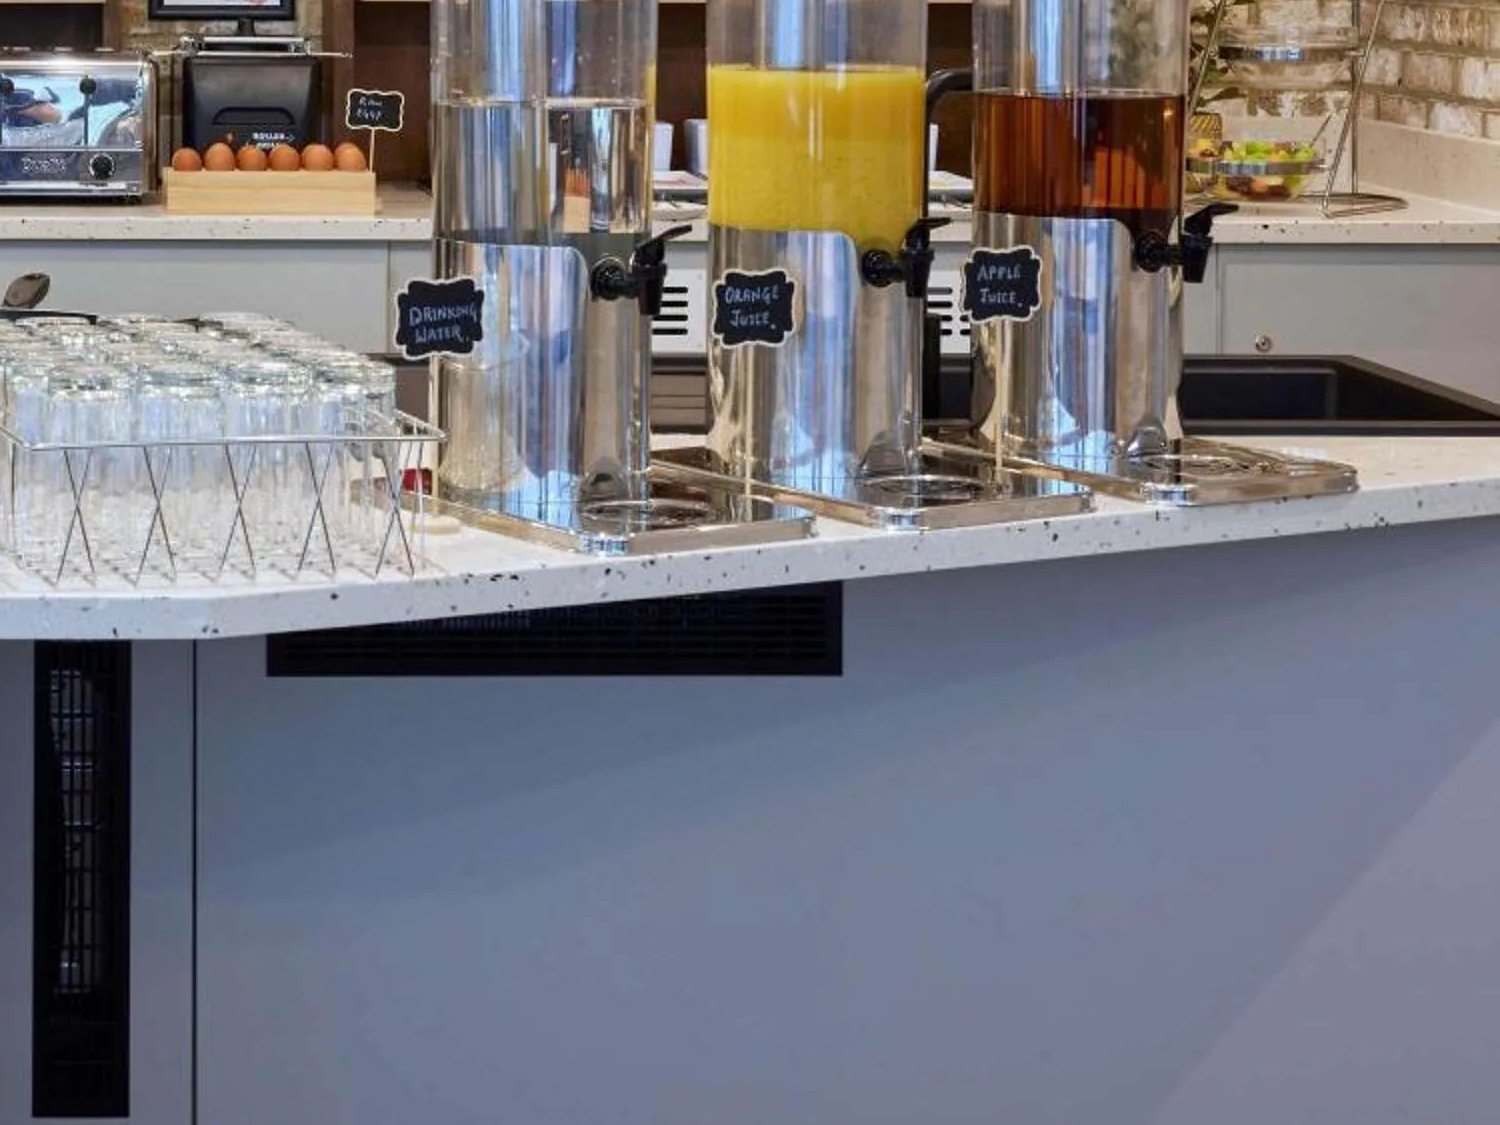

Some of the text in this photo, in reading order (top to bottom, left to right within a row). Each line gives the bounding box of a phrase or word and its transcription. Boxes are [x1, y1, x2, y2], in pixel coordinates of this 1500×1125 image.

[976, 263, 1022, 282] APPLE
[725, 284, 779, 305] ORANGE
[409, 303, 478, 327] DRINKING
